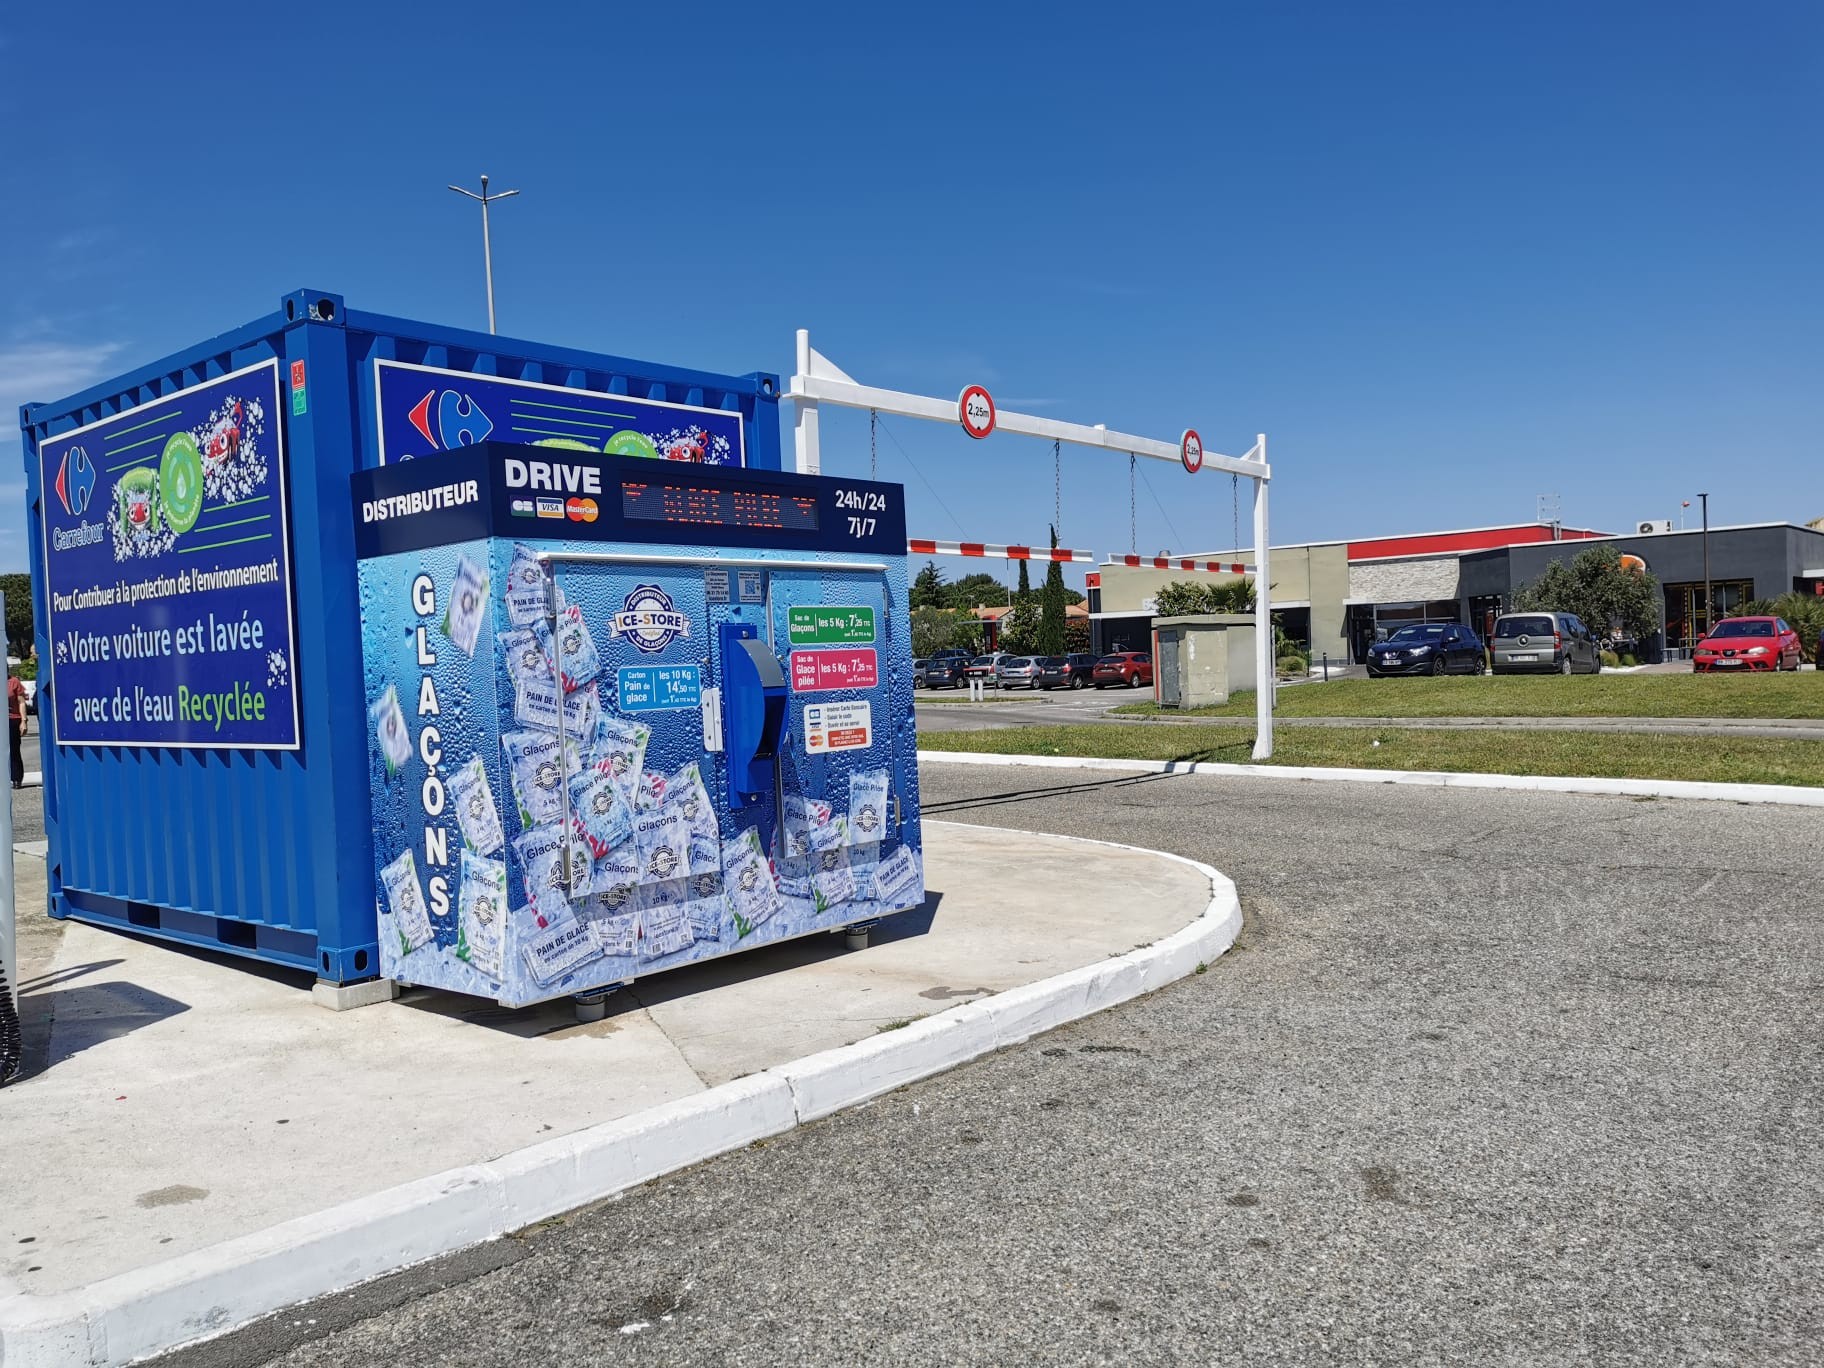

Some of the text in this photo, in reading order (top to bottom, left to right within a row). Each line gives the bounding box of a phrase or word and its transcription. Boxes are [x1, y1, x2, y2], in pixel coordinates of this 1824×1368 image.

[505, 458, 602, 495] DRIVE
[362, 479, 479, 523] DISTRIBUTEUR
[541, 503, 560, 512] VISA
[835, 489, 886, 512] 24h/24
[566, 504, 599, 515] MasterCard
[53, 520, 104, 551] Carrefour
[847, 516, 876, 539] 7j/7
[53, 557, 279, 612] Pour Contribuer à la protection de l'environnement
[513, 598, 527, 606] PAIN
[630, 590, 668, 606] DISTRIBUTEUR
[618, 613, 682, 628] ICE-STORE
[790, 623, 815, 634] Glaçons
[818, 617, 828, 627] les
[829, 617, 835, 627] 5
[835, 617, 845, 629] Kg
[68, 609, 264, 664] Votre voiture est lavée
[636, 635, 644, 644] DE
[644, 635, 668, 648] GLAÇONS
[796, 655, 814, 663] Sac de
[627, 671, 647, 680] Carton
[659, 671, 669, 680] les
[671, 670, 680, 680] 10
[681, 670, 692, 681] Kg
[796, 664, 816, 674] Glace
[820, 663, 831, 673] les
[832, 663, 837, 672] 5
[837, 662, 847, 674] Kg
[624, 680, 651, 691] Pain de
[797, 675, 815, 688] pilée
[74, 680, 266, 732] avec de l'eau Recyclée
[526, 691, 542, 702] PAIN
[544, 695, 553, 705] DE
[626, 693, 648, 705] glace
[412, 575, 450, 917] GLAÇONS
[607, 729, 638, 747] Glaçons
[522, 739, 560, 757] Glaçons
[573, 781, 593, 798] Glace
[668, 781, 695, 800] Glaçons
[787, 808, 807, 821] Glace
[638, 814, 678, 833] Glaçons
[526, 840, 560, 860] Glace
[726, 846, 754, 869] Glaçons
[648, 855, 679, 871] ICE-STORE
[472, 870, 501, 891] Glaçons
[536, 922, 590, 957] PAIN DE GLACE
